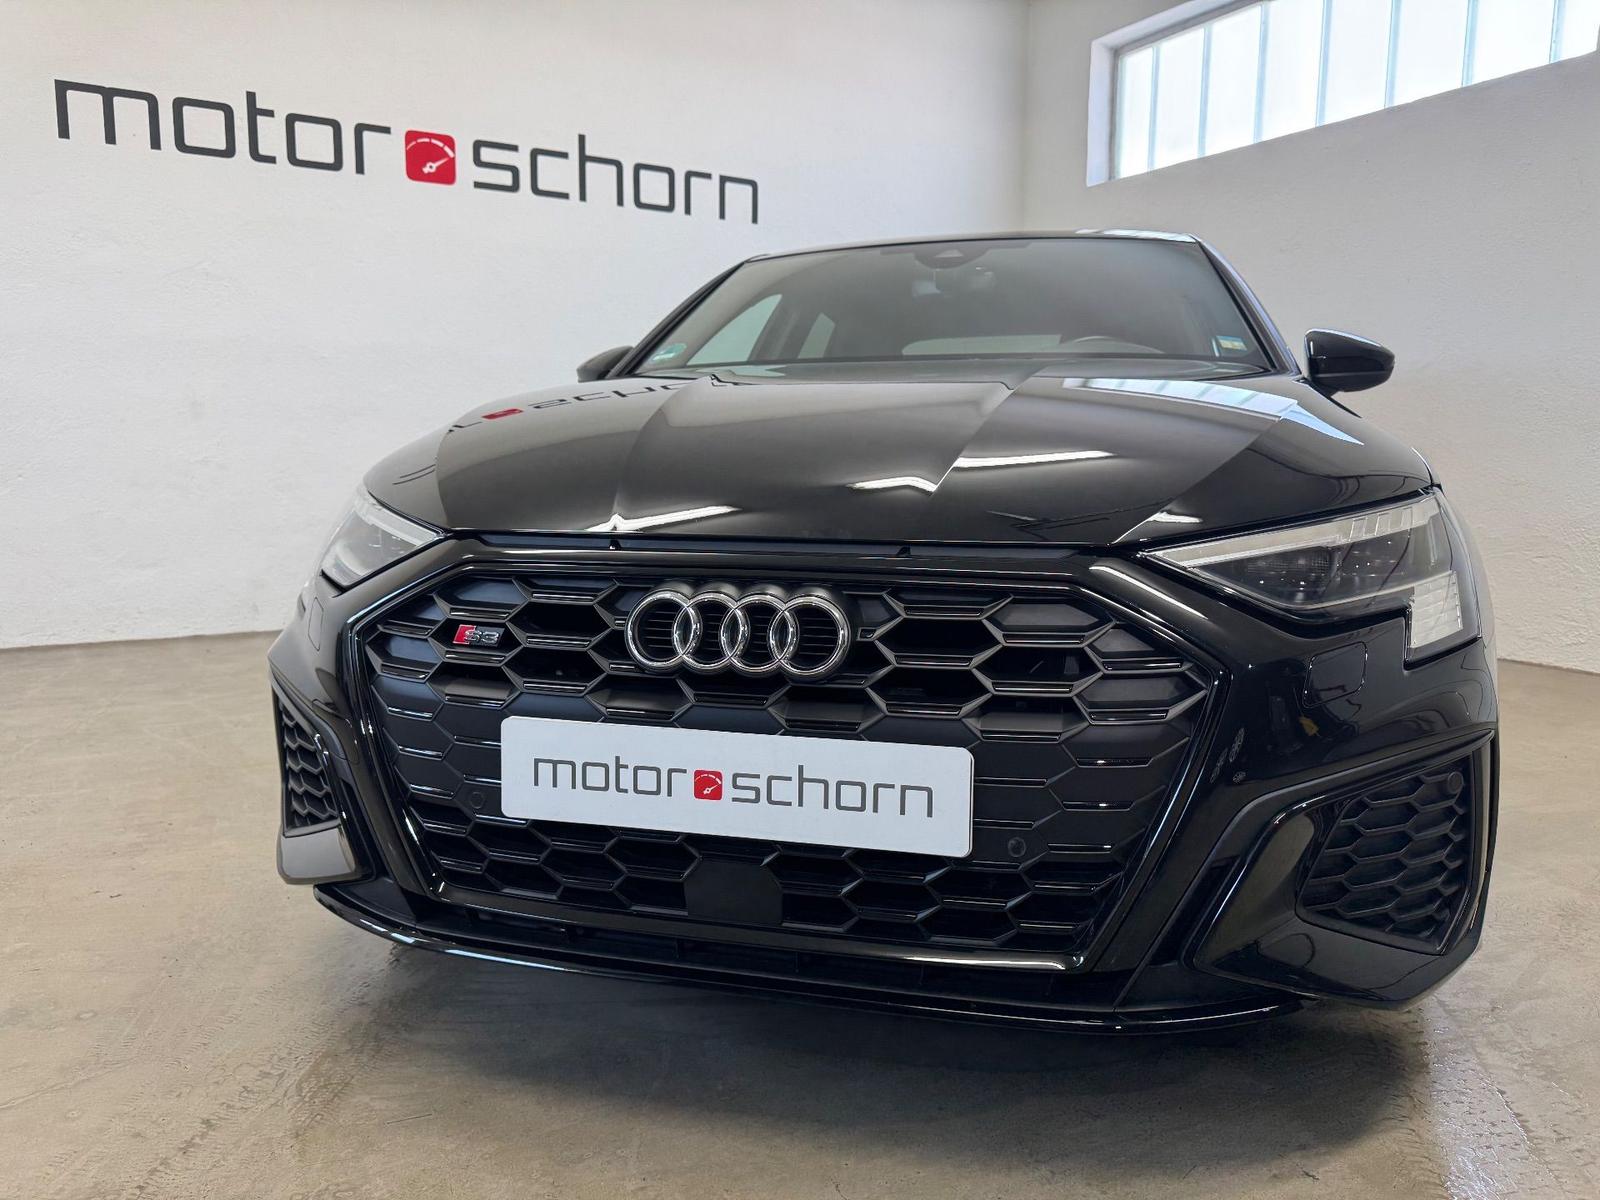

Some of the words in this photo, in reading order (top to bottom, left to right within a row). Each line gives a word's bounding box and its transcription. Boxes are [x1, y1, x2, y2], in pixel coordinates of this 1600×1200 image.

[54, 79, 391, 175] motor
[472, 134, 759, 225] schorn
[462, 628, 501, 645] S3
[533, 756, 688, 798] motor
[731, 764, 933, 819] schorn
